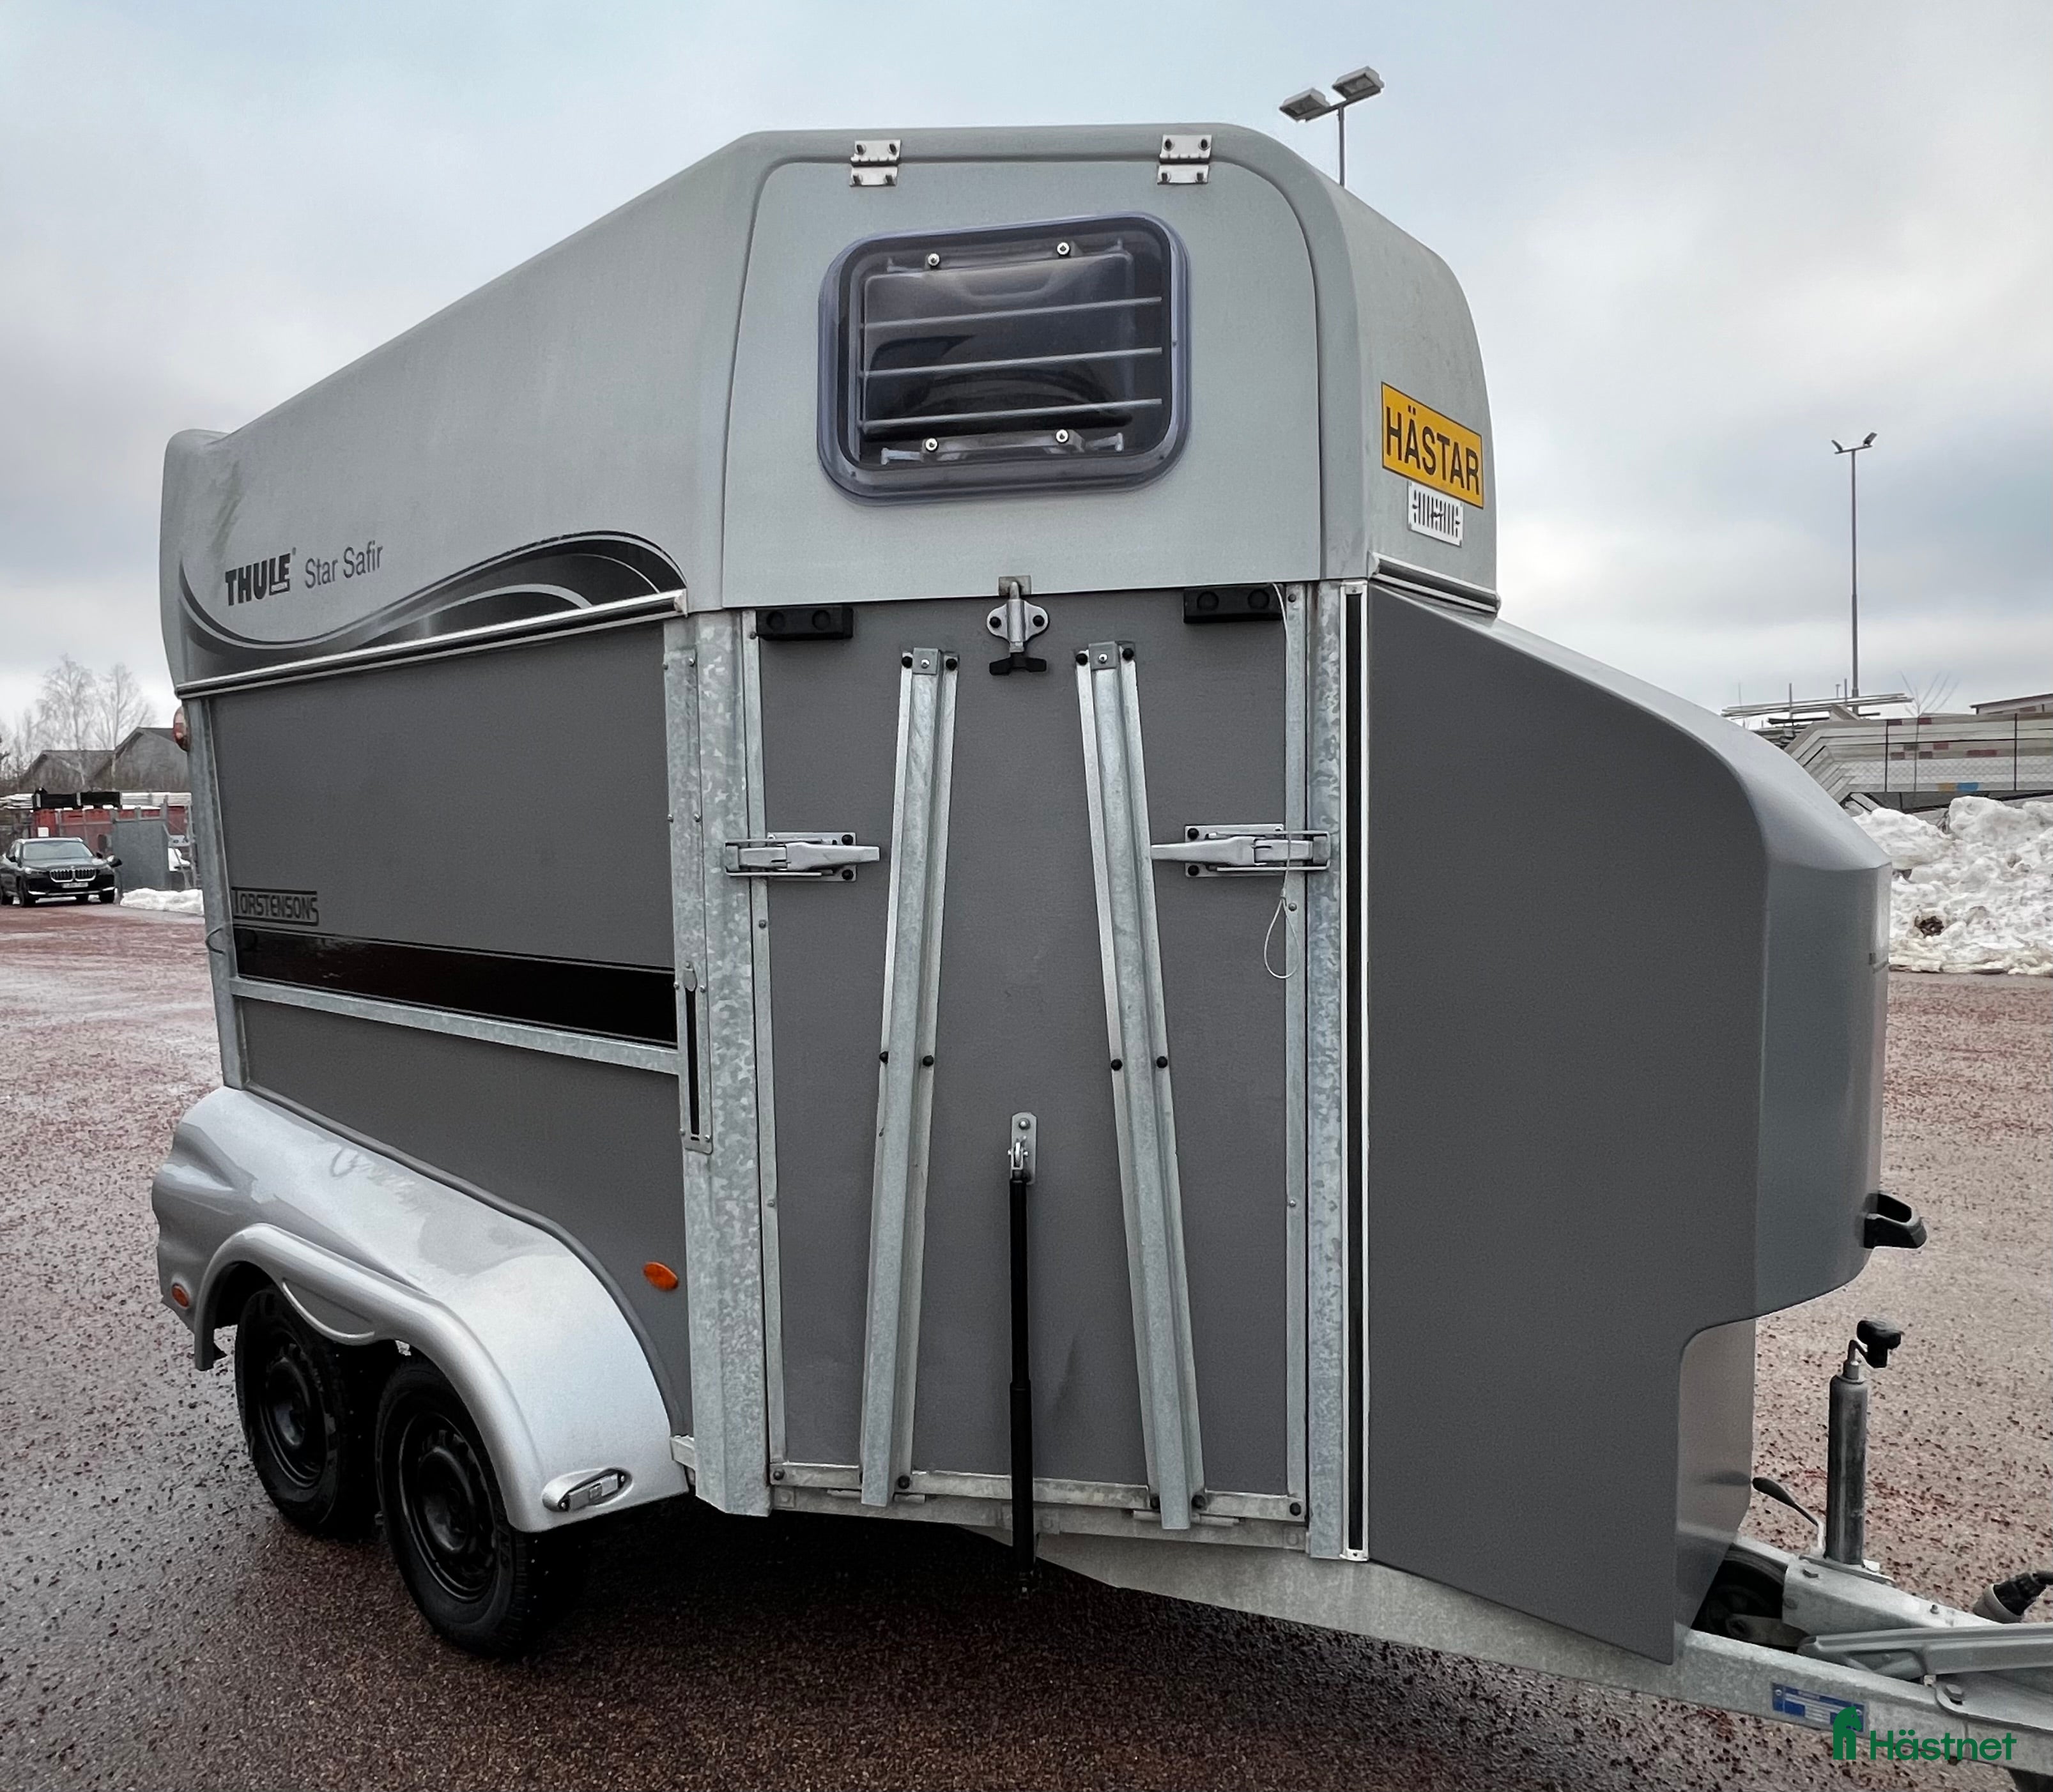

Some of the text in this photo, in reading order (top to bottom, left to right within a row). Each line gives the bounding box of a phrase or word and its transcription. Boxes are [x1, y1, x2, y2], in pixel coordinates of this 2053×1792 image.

[1386, 405, 1480, 495] HÄSTAR
[225, 553, 291, 606] THULE
[305, 540, 383, 588] Star Safir
[231, 887, 319, 926] TORSTENSONS
